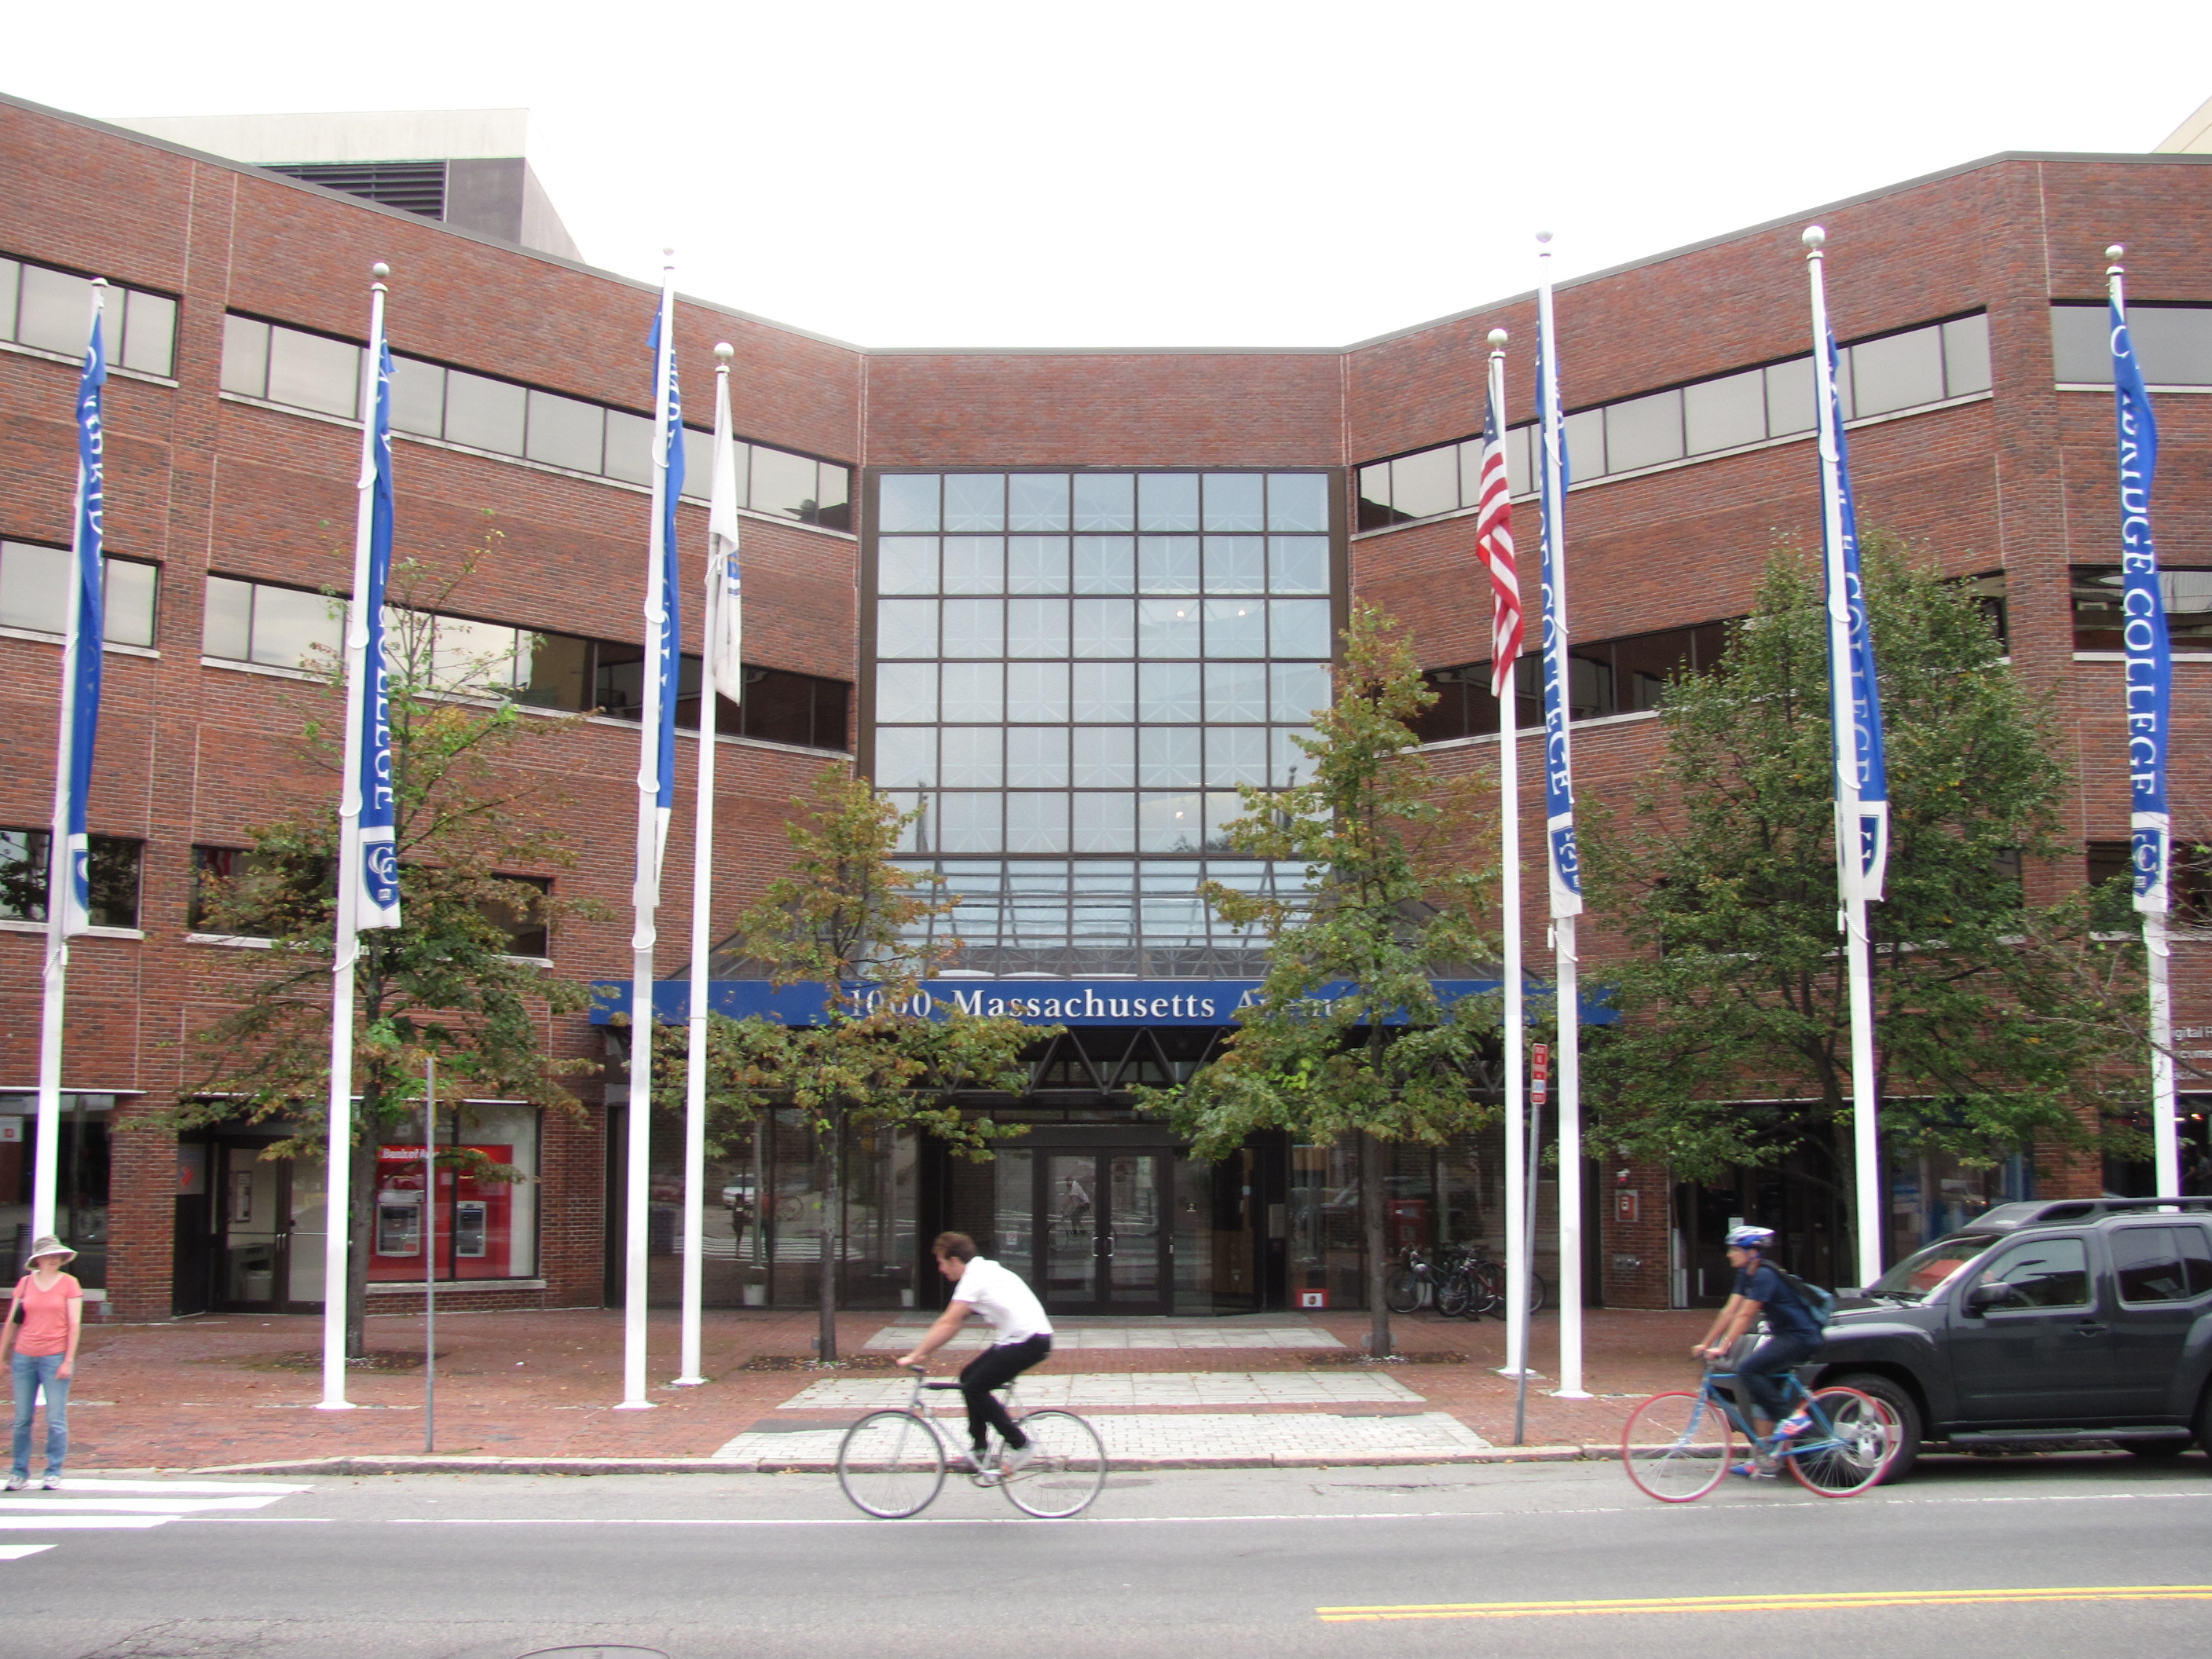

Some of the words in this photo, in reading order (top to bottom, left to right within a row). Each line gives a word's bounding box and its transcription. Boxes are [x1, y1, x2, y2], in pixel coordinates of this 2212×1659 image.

[2111, 324, 2156, 575] CBRIDGE
[375, 604, 394, 811] LLEGE
[2123, 588, 2157, 797] COLLEGE
[849, 989, 932, 1017] 1000
[951, 987, 1215, 1018] Massachusetts
